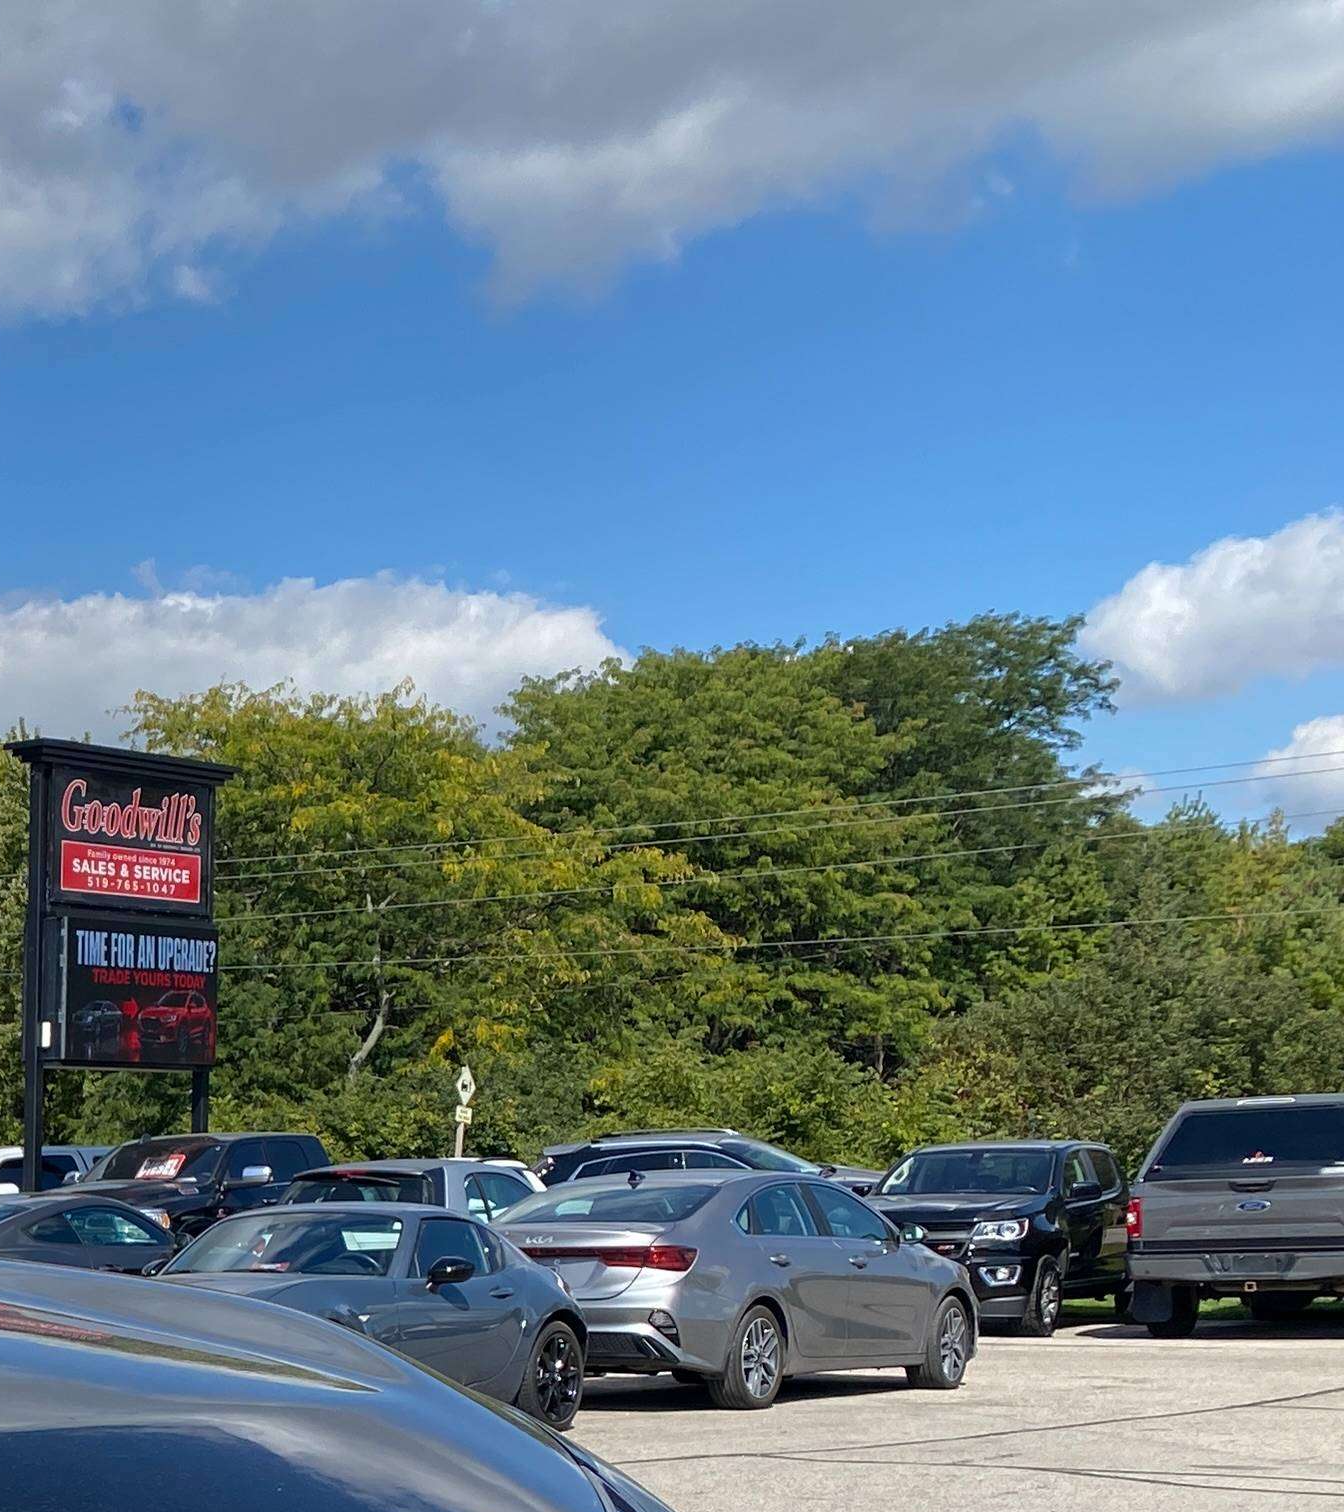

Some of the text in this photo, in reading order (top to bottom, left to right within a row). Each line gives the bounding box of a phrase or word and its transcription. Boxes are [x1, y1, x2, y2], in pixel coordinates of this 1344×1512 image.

[61, 779, 202, 846] Goodwill's
[87, 849, 111, 860] Family
[112, 853, 137, 863] owned
[138, 856, 158, 865] since
[72, 858, 190, 884] SALES & SERVICE
[87, 877, 176, 895] 519-765-1047
[76, 930, 216, 974] TIME FOR AN UPGRADE?
[93, 968, 205, 989] TRADE YOURS TODAY
